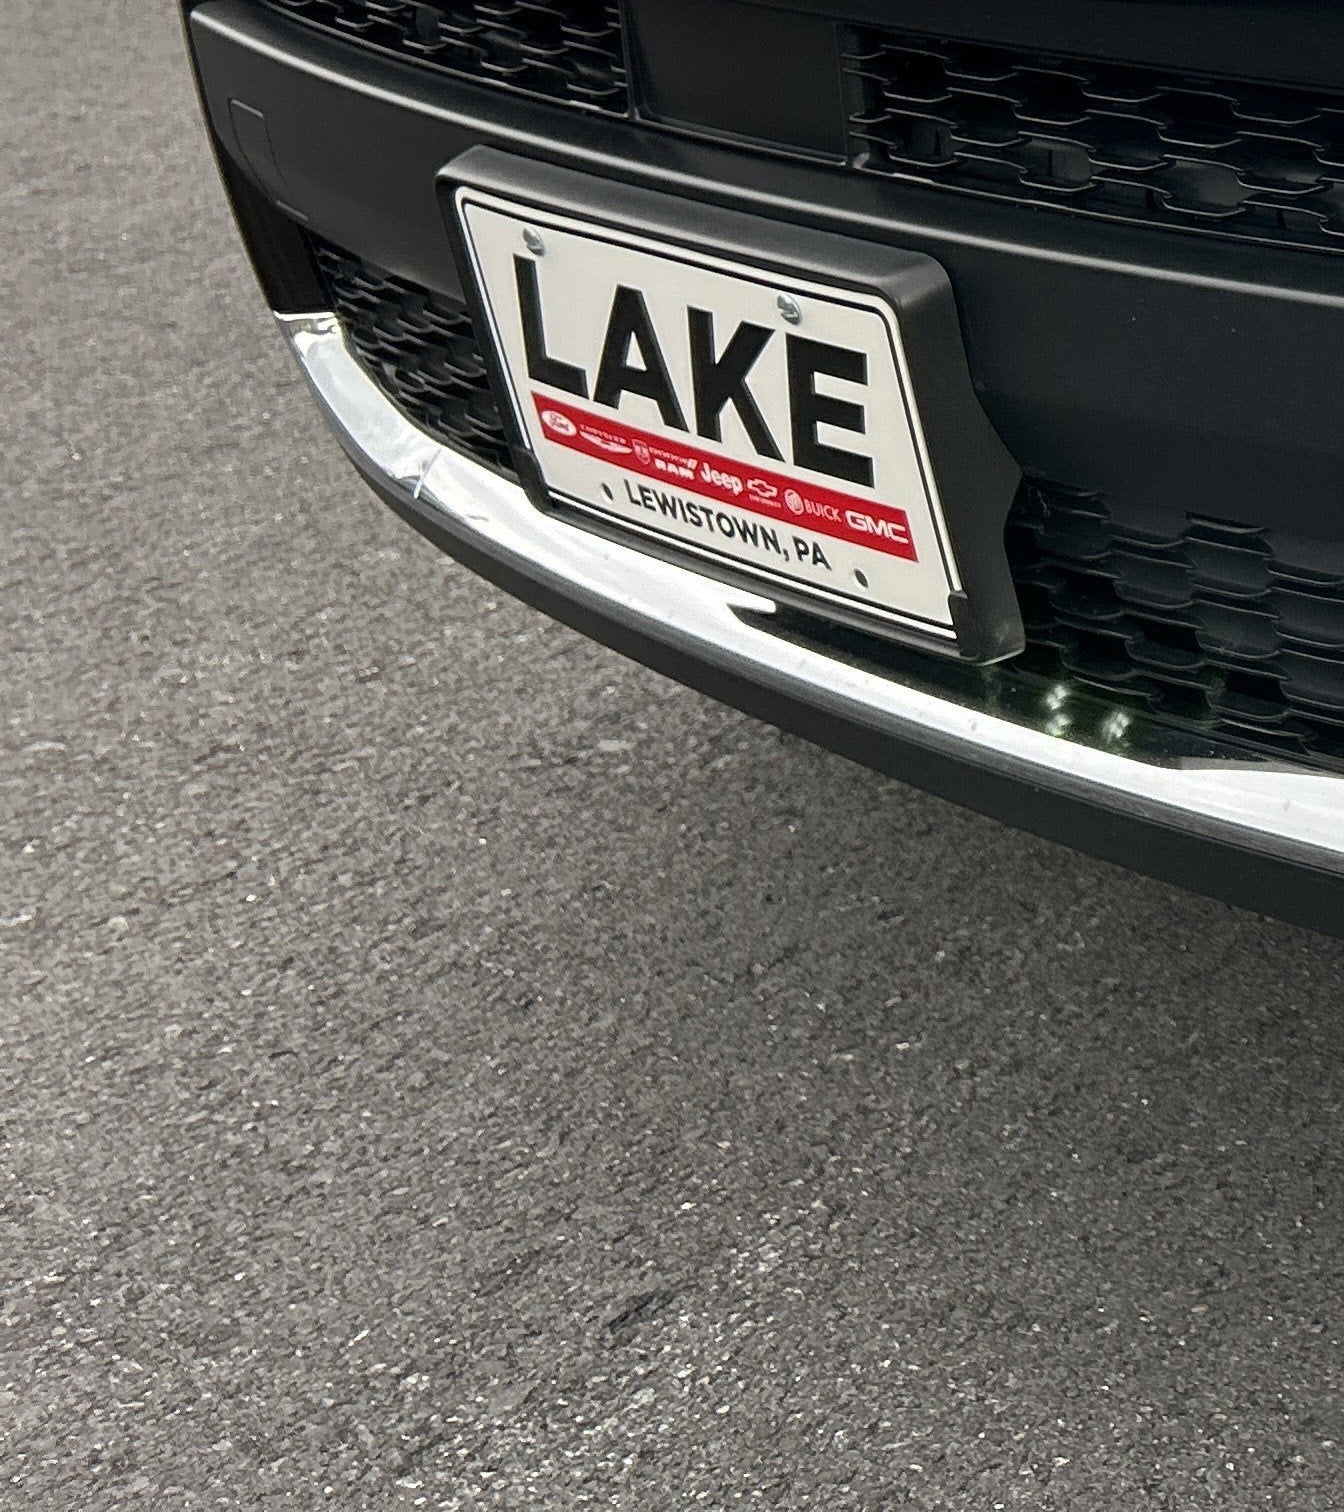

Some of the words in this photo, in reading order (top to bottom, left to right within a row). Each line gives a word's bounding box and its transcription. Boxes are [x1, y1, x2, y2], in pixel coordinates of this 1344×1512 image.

[513, 253, 875, 489] LAKE
[624, 479, 790, 562] LEWISTOWN,
[792, 535, 832, 572] PA
[700, 462, 743, 496] Jeep
[804, 498, 842, 523] BUICK
[845, 510, 909, 544] GMC
